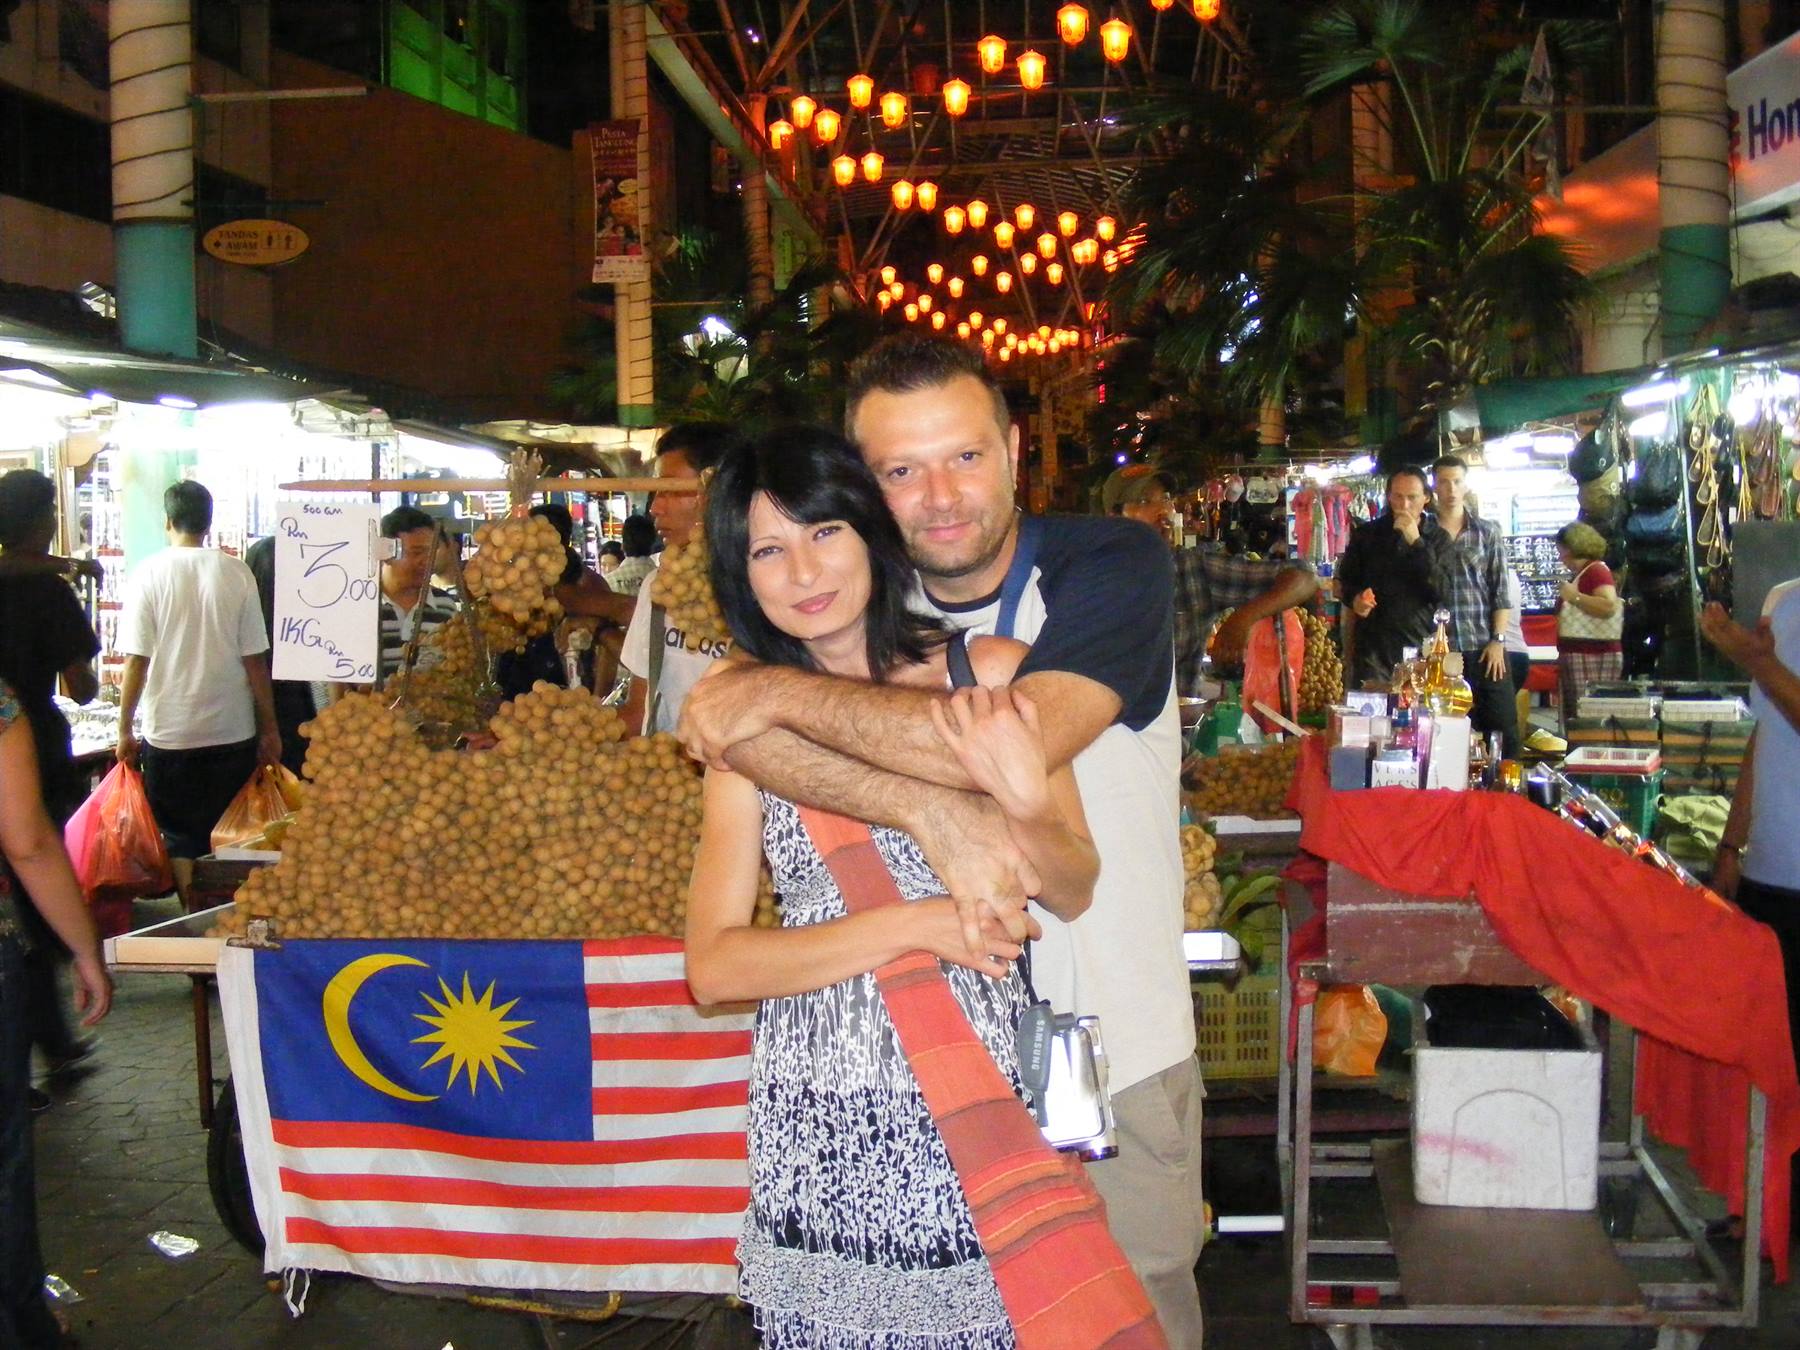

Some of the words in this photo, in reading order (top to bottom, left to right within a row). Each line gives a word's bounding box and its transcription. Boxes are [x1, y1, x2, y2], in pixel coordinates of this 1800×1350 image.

[226, 241, 258, 250] AWAM
[303, 504, 322, 514] 500
[1031, 1019, 1045, 1070] SAMSUNG
